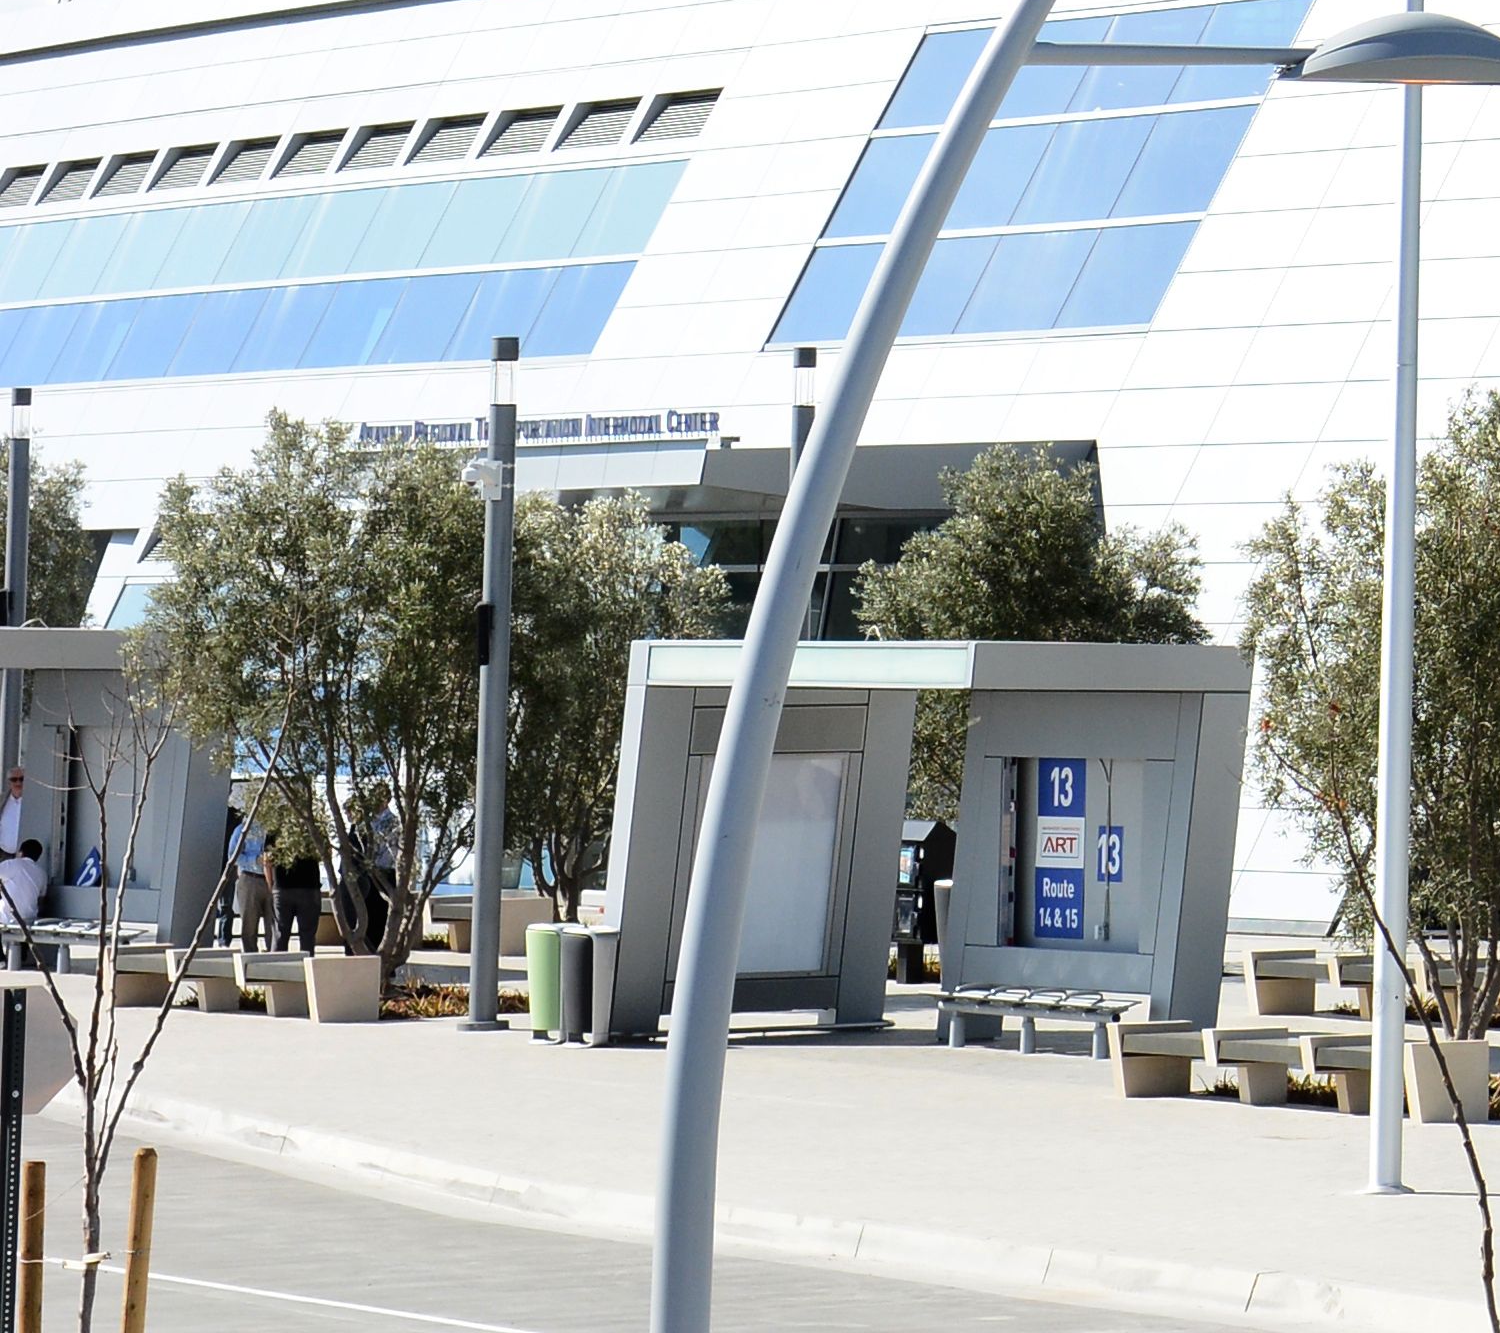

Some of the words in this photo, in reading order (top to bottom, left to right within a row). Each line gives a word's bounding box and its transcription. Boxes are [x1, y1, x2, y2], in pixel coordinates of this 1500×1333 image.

[667, 409, 720, 432] CENTER
[1050, 766, 1073, 808] 13
[1043, 837, 1077, 854] ART
[1097, 833, 1121, 876] 13
[1042, 877, 1075, 900] Route
[1039, 907, 1052, 927] 14
[1053, 907, 1062, 928] &
[1065, 909, 1078, 929] 15
